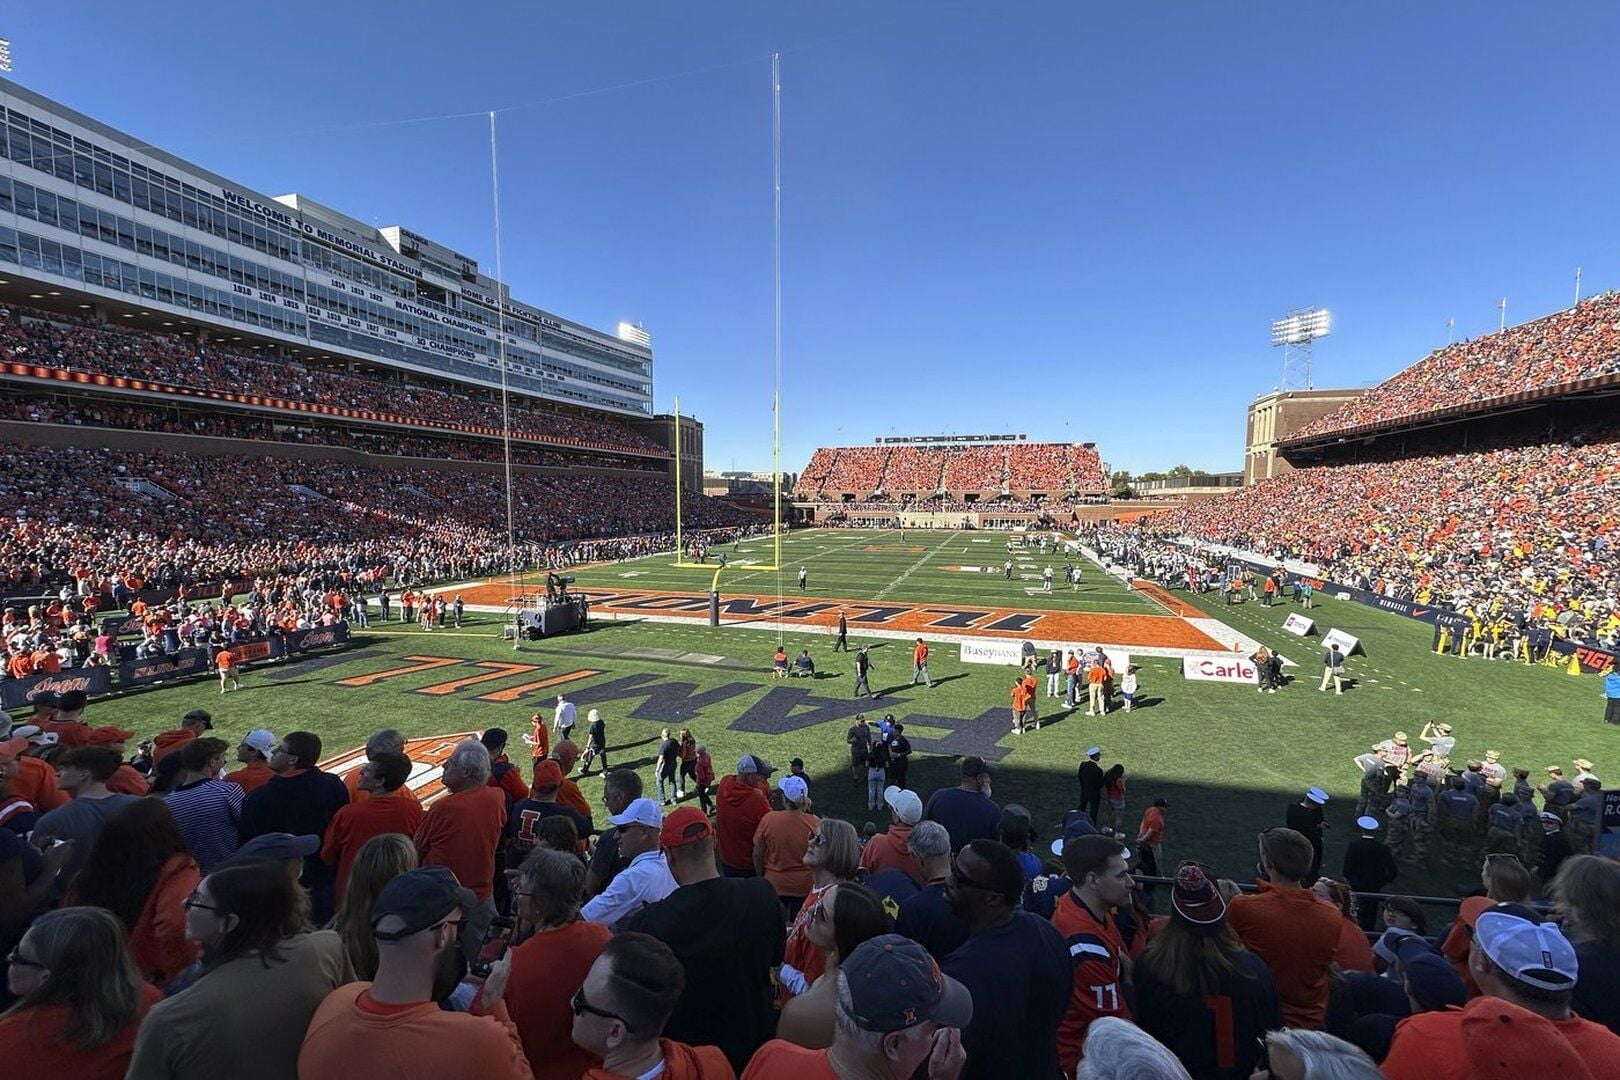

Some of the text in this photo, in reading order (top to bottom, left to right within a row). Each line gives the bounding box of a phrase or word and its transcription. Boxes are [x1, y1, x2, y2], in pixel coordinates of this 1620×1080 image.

[222, 189, 292, 225] WELCOME
[295, 219, 313, 234] TO
[317, 229, 377, 259] MEMORIAL
[380, 255, 423, 278] STADIUM
[461, 287, 483, 302] HOME
[395, 300, 487, 336] NATIONAL CHAMPIONS
[429, 341, 476, 359] CHAMPIONS
[1200, 661, 1253, 679] Carle
[518, 809, 541, 842] I
